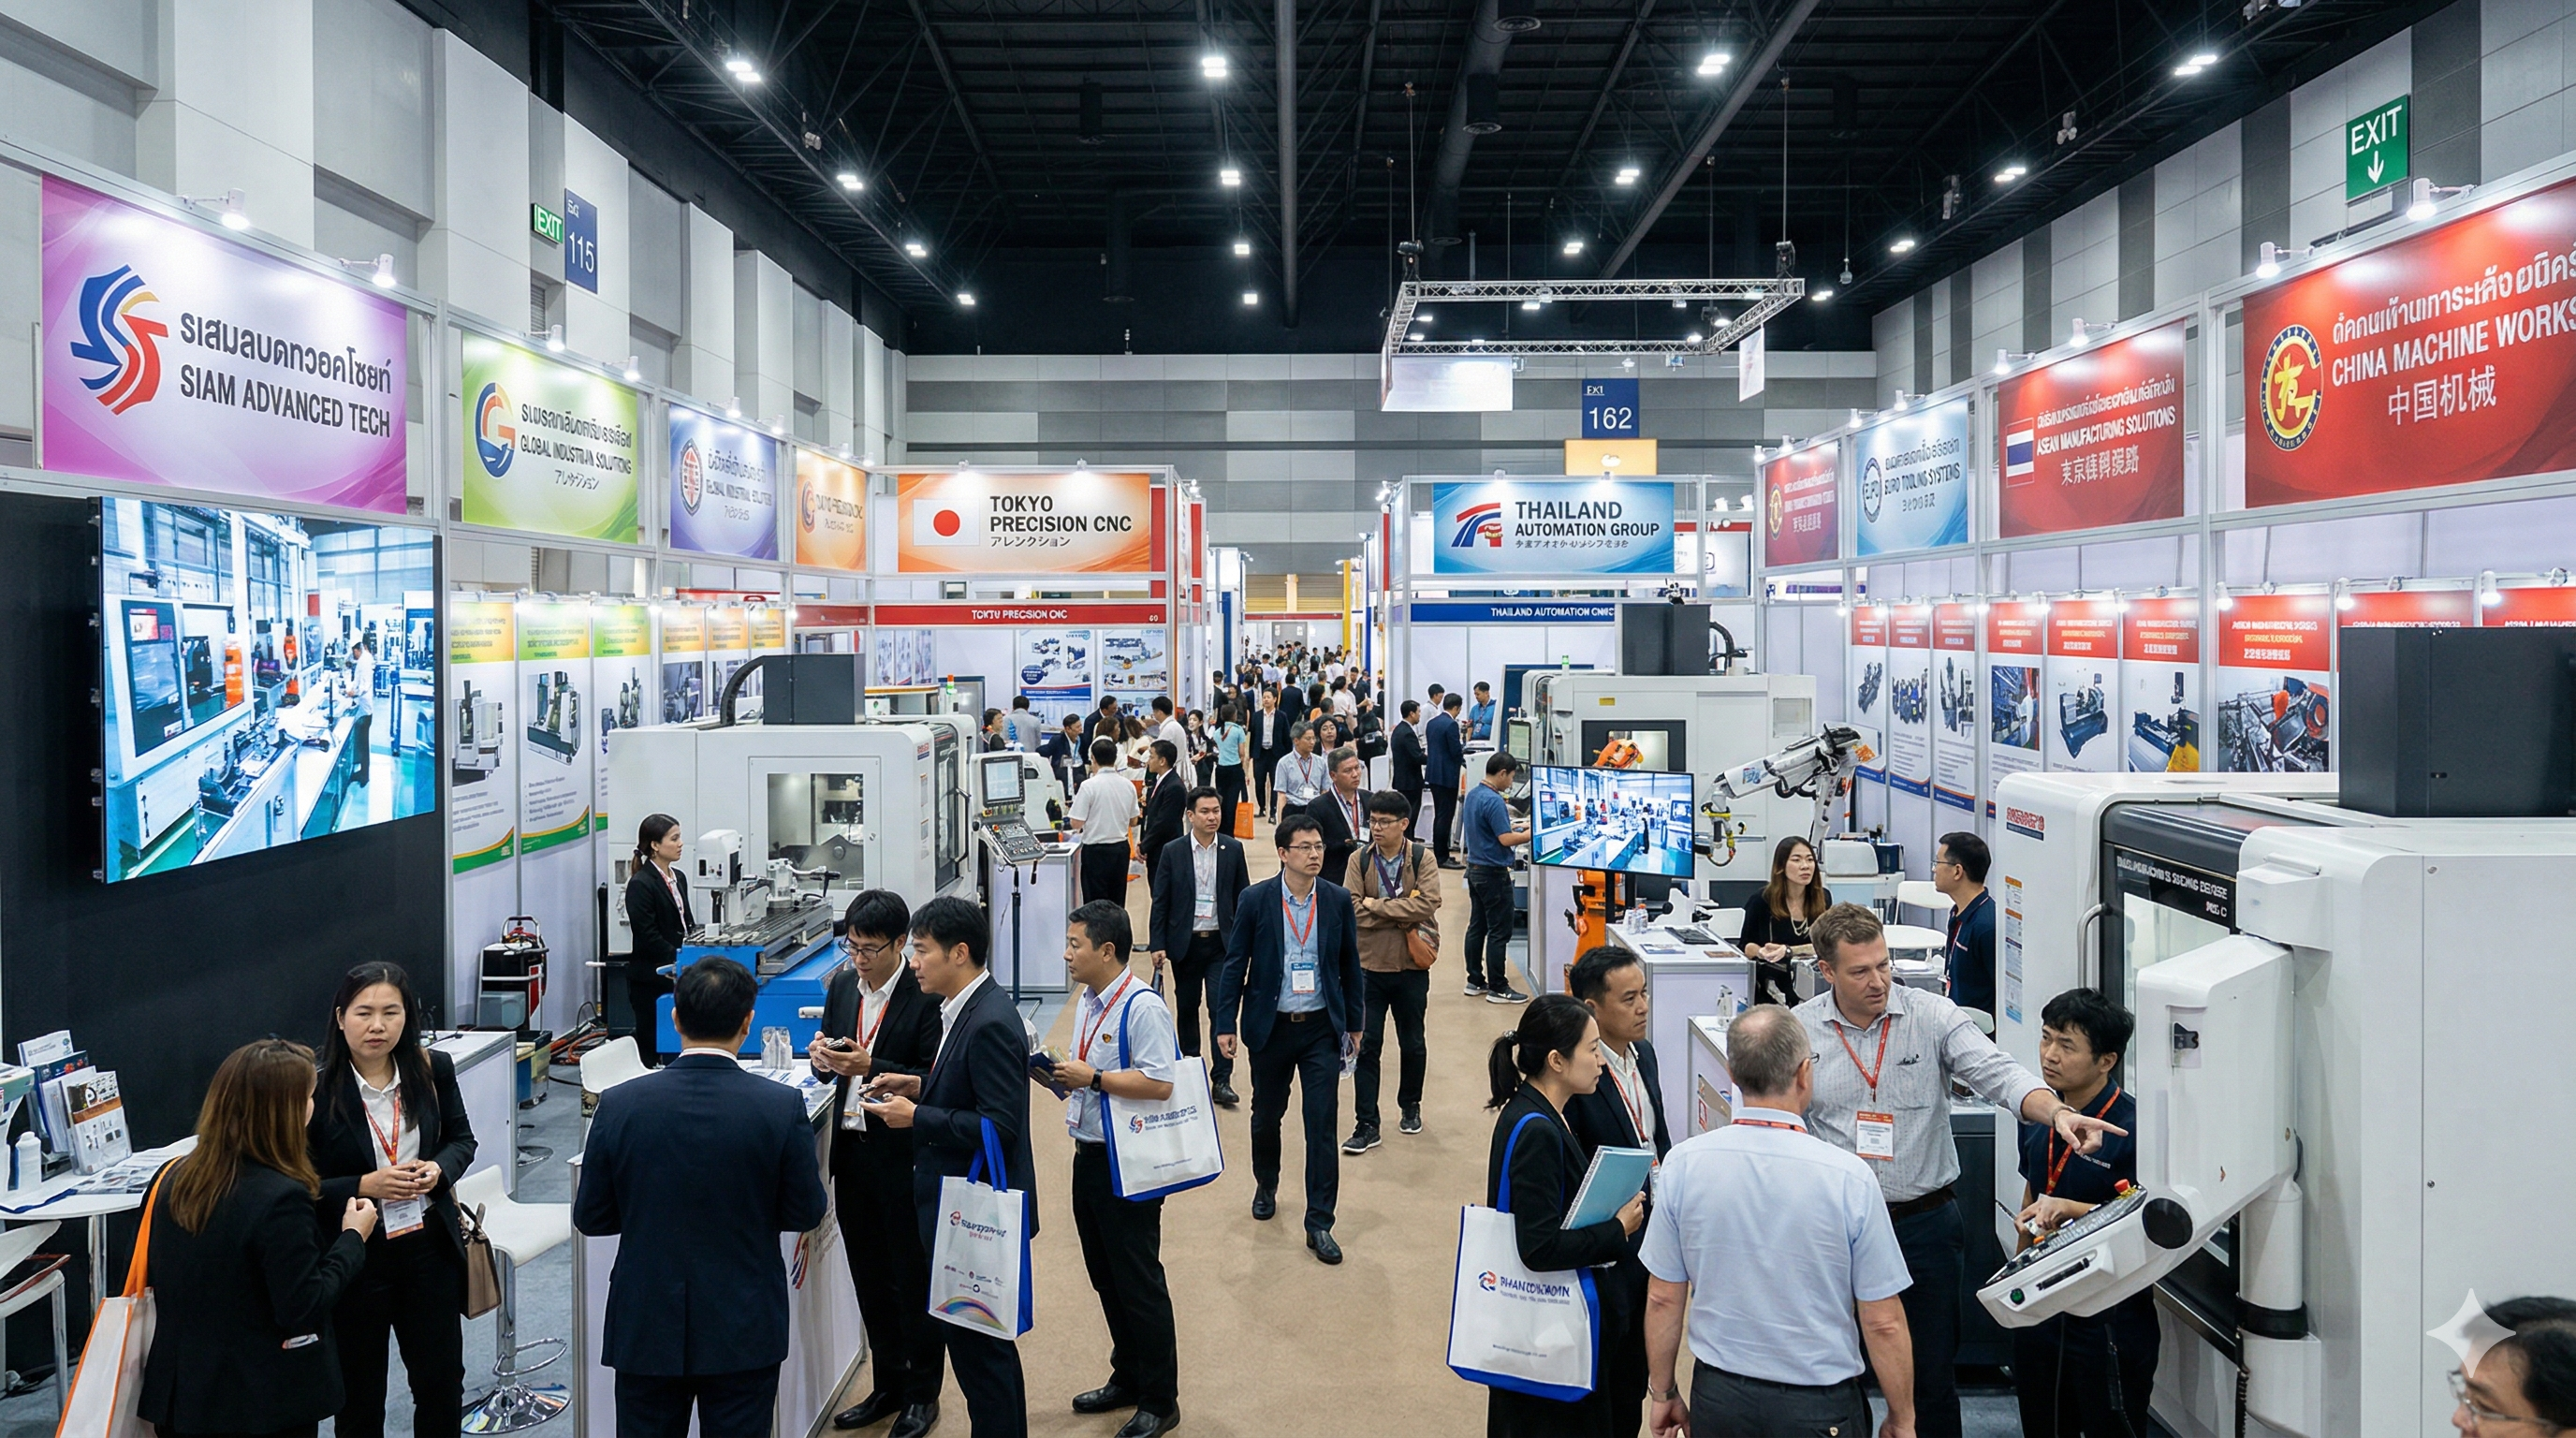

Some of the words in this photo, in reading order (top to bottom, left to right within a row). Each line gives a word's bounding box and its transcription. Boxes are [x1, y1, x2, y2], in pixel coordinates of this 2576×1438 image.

[2351, 104, 2403, 156] EXIT
[537, 206, 563, 241] EXIT
[569, 231, 594, 273] 115
[2332, 346, 2388, 388] CHINA
[2393, 319, 2489, 373] MACHINE
[181, 364, 236, 406] SIAM
[242, 378, 344, 428] ADVANCED
[348, 403, 390, 438] TECH
[2388, 364, 2497, 425] 中国机械
[1588, 406, 1632, 430] 162
[2037, 434, 2060, 457] ASEAN
[2126, 405, 2176, 435] SOLUTIONS
[989, 495, 1054, 512] TOKYO
[1515, 501, 1622, 520] THAILAND
[989, 516, 1088, 532] PRECISION
[1093, 516, 1132, 532] CNC
[1515, 522, 1606, 536] AUTOMATION
[1610, 522, 1661, 536] GROUP
